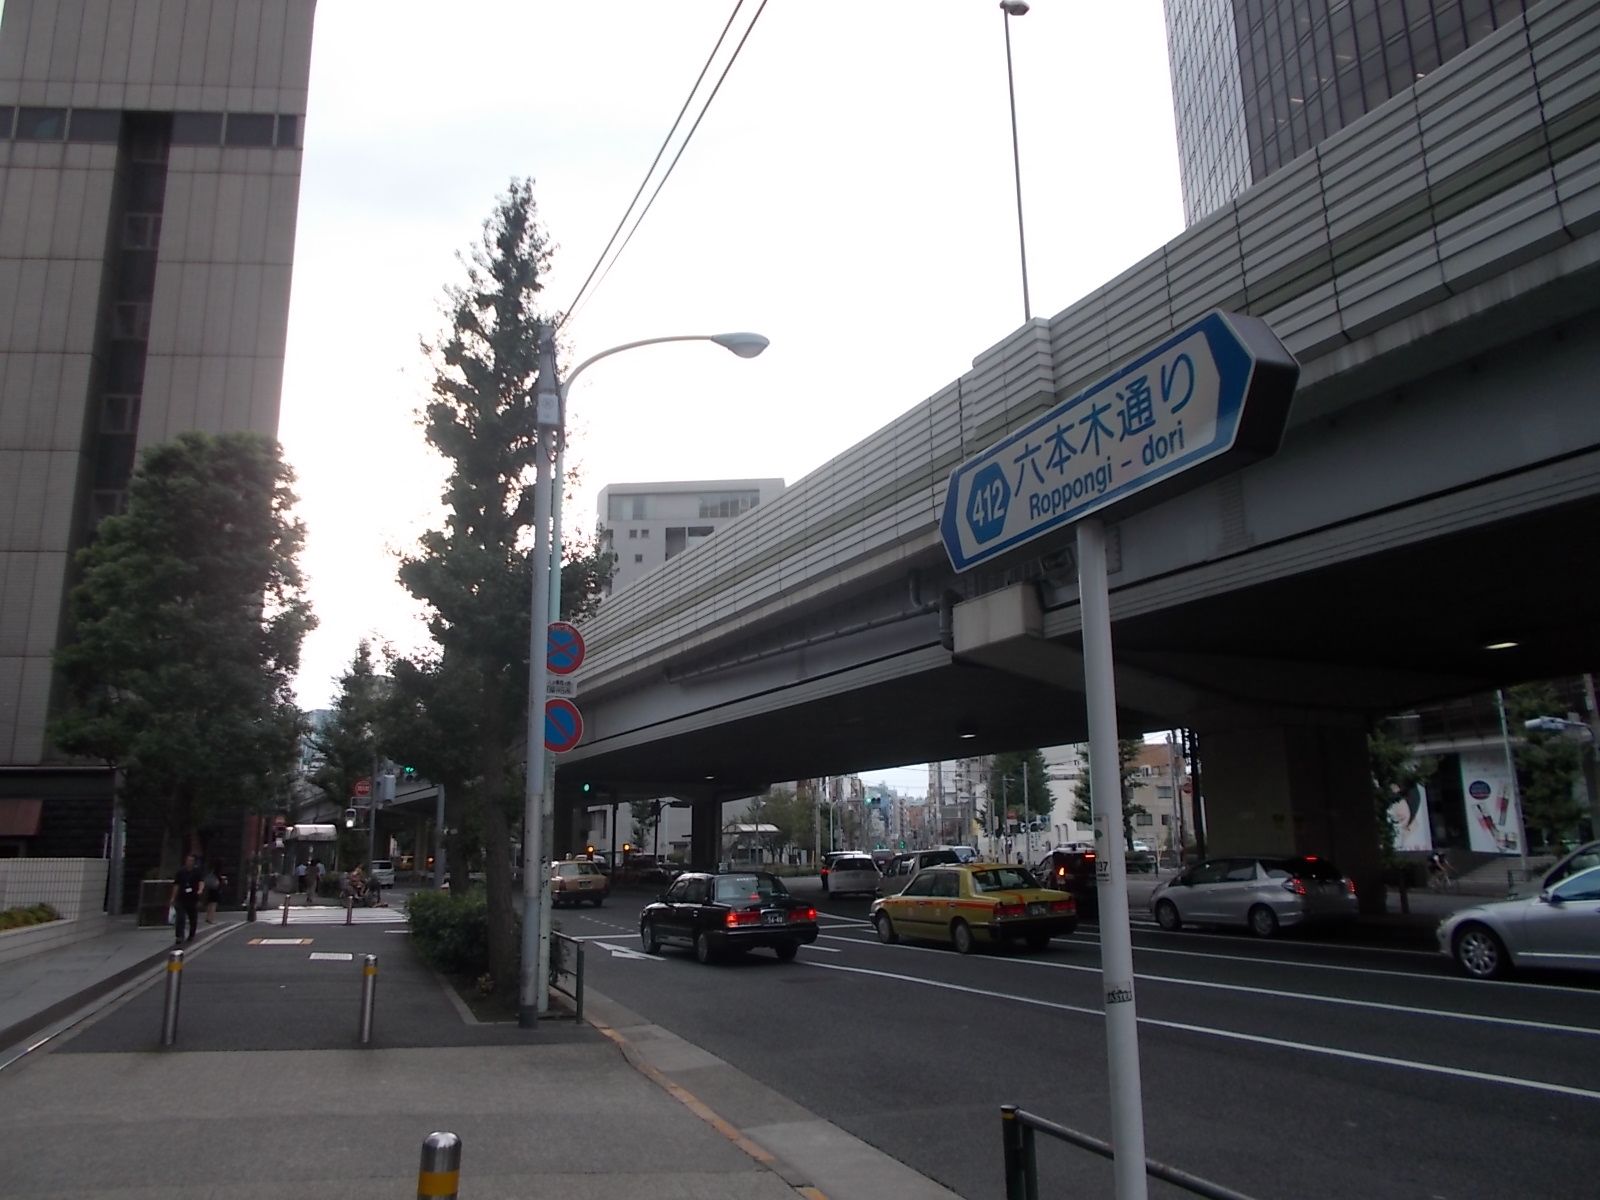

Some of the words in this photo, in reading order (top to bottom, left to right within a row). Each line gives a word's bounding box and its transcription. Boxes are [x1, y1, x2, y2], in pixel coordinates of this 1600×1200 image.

[1013, 353, 1195, 498] 六本木通り
[1029, 456, 1112, 520] Roppongi
[1142, 421, 1185, 467] dori
[972, 479, 1006, 527] 412
